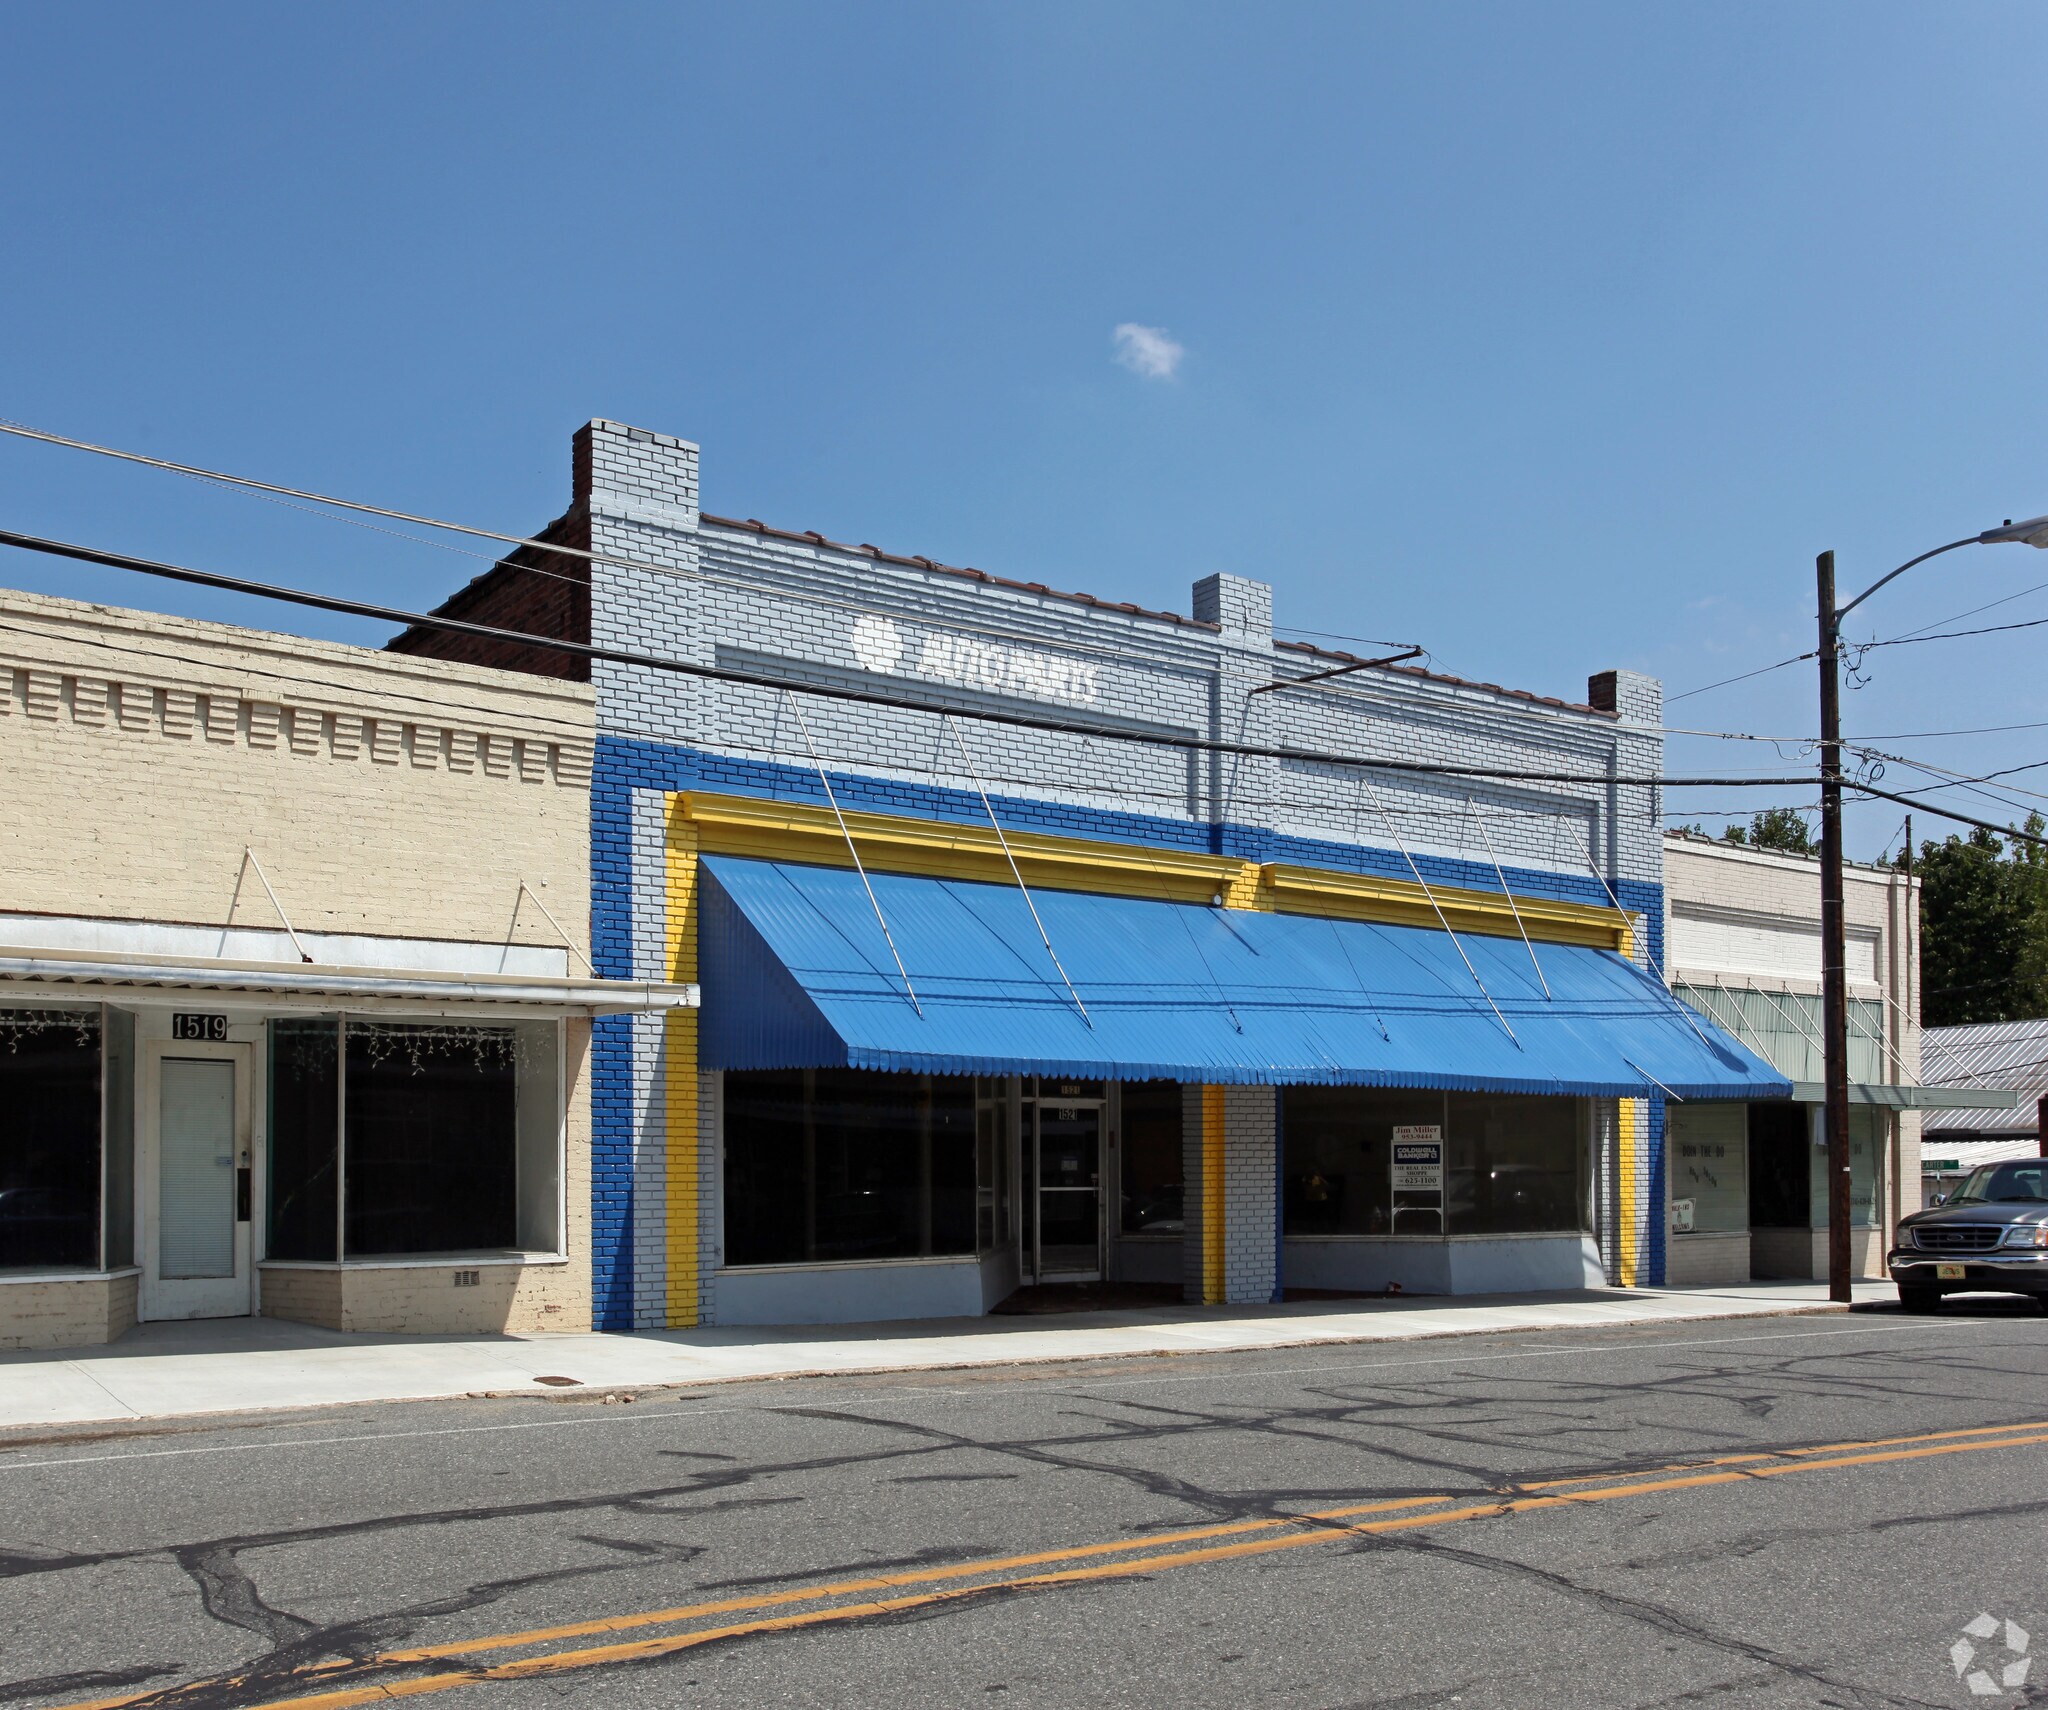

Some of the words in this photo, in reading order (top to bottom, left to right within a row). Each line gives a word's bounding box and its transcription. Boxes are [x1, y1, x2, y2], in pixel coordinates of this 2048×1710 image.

[175, 1015, 226, 1039] 1519
[1062, 1086, 1079, 1094] 1521
[1060, 1109, 1077, 1119] 1521
